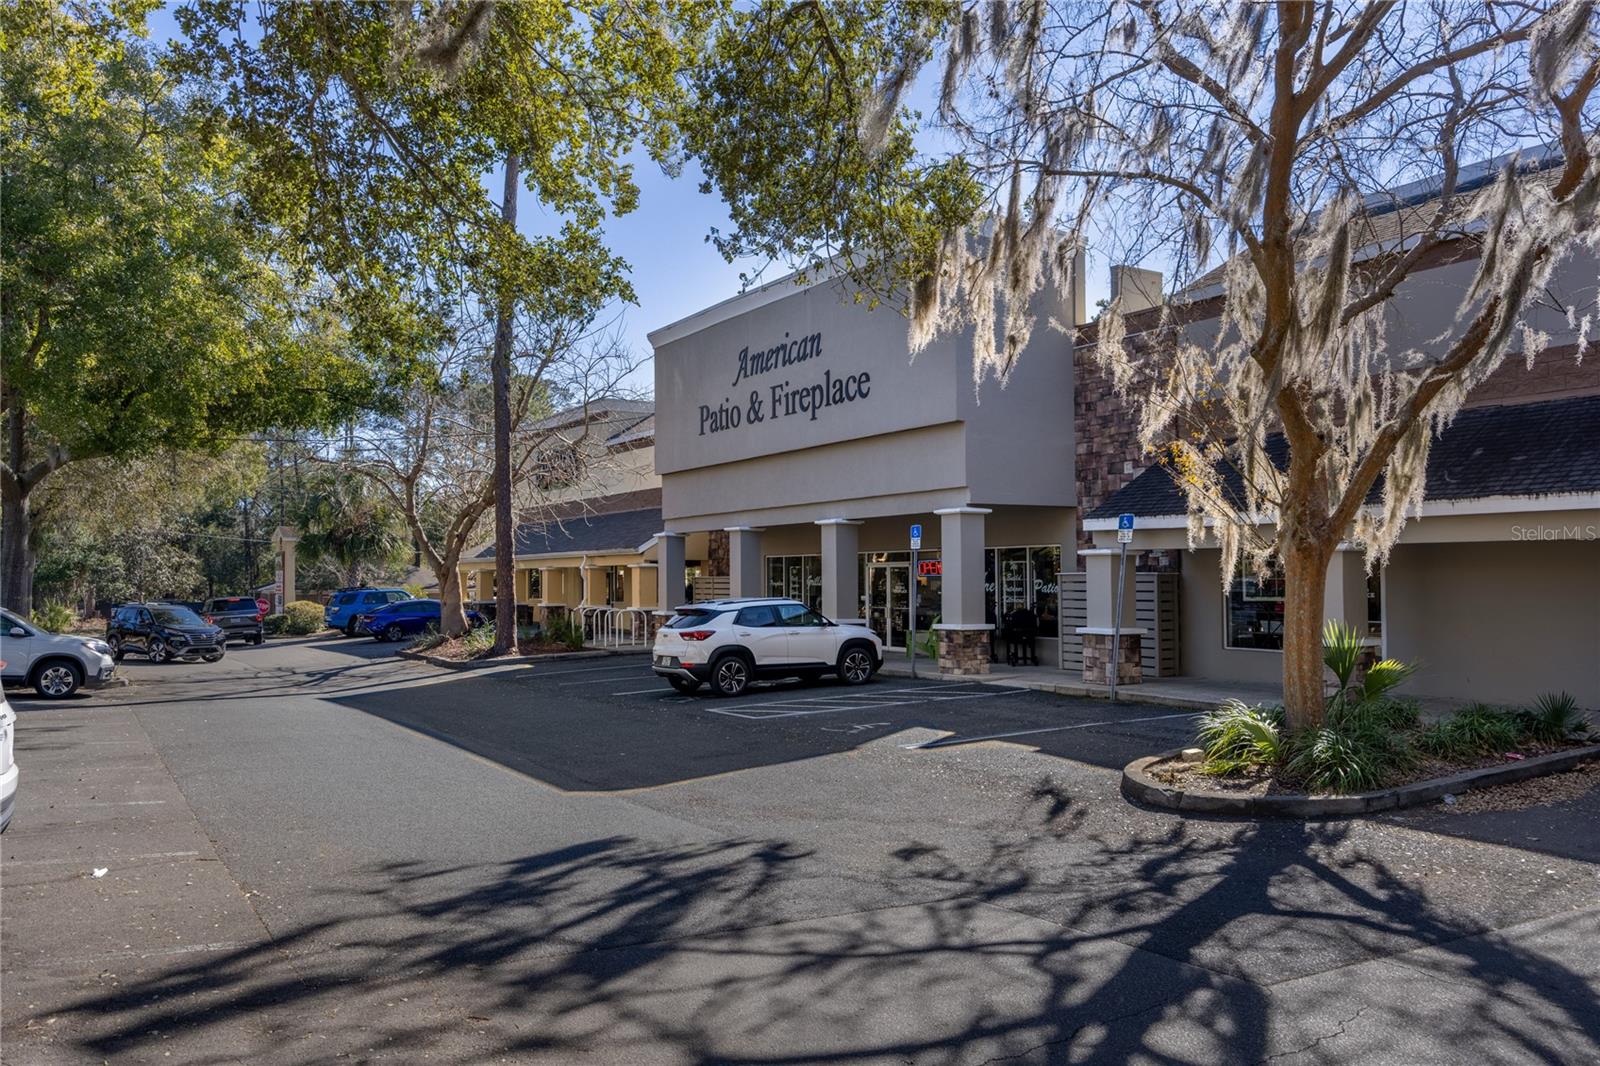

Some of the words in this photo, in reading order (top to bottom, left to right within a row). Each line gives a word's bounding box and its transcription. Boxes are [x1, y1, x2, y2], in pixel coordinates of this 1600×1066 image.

[732, 331, 823, 387] American
[698, 397, 742, 437] Patio
[746, 390, 765, 425] &
[770, 369, 872, 421] Fireplace
